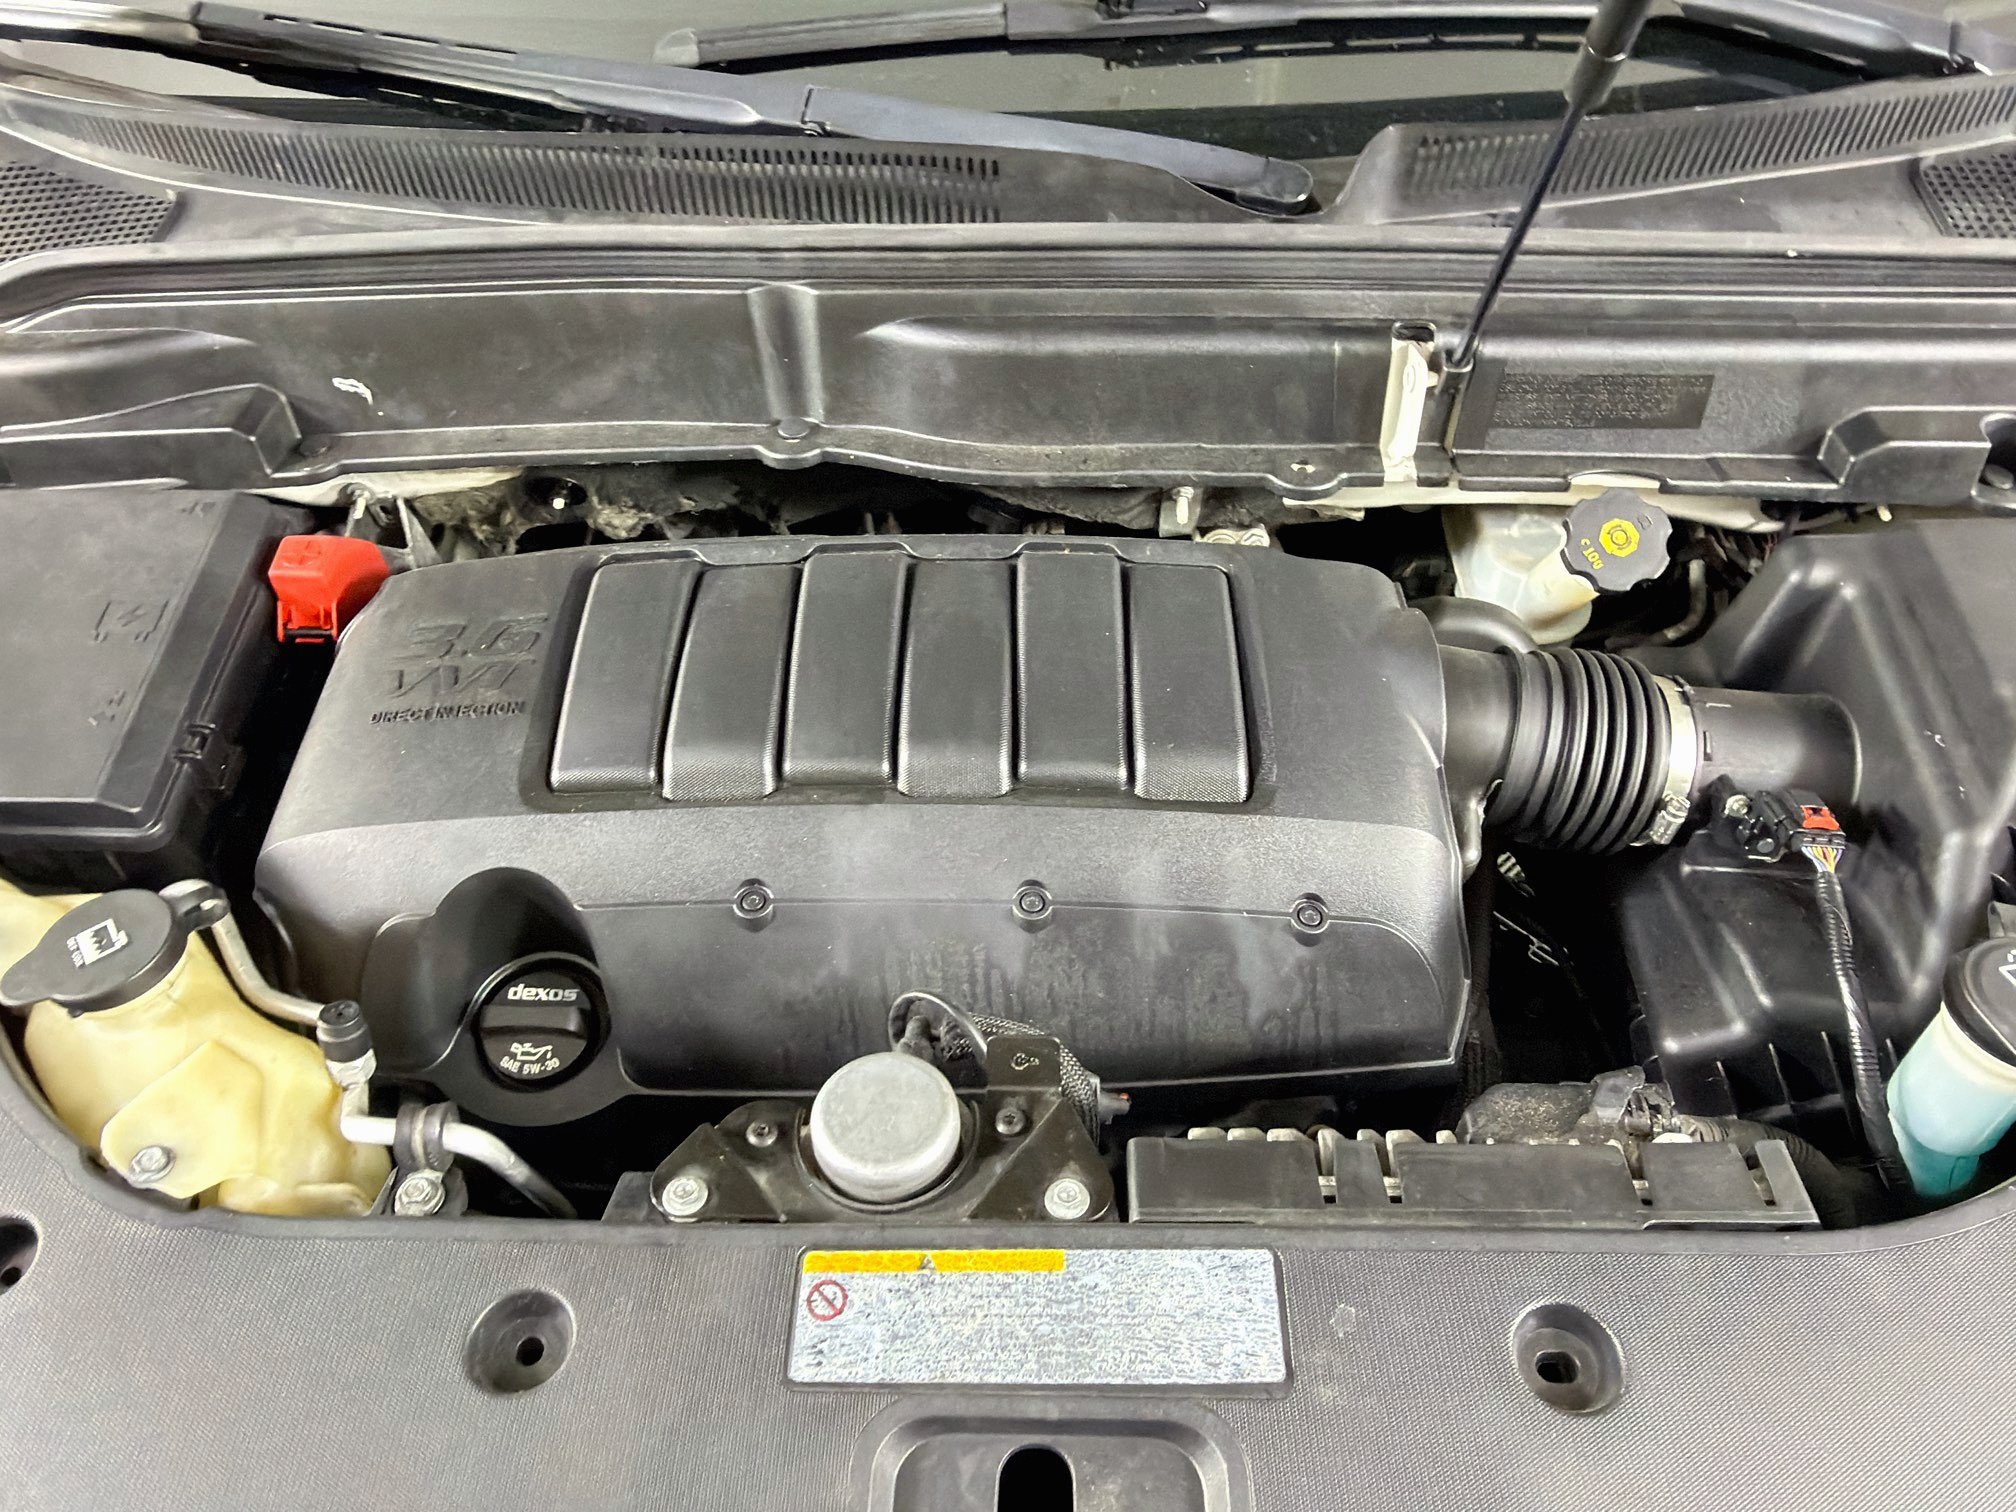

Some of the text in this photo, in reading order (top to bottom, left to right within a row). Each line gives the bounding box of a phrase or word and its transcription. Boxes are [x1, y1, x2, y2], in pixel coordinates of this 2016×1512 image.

[393, 614, 549, 659] 3.6
[507, 983, 580, 1002] dexos
[500, 1056, 560, 1074] SAE 5W-30
